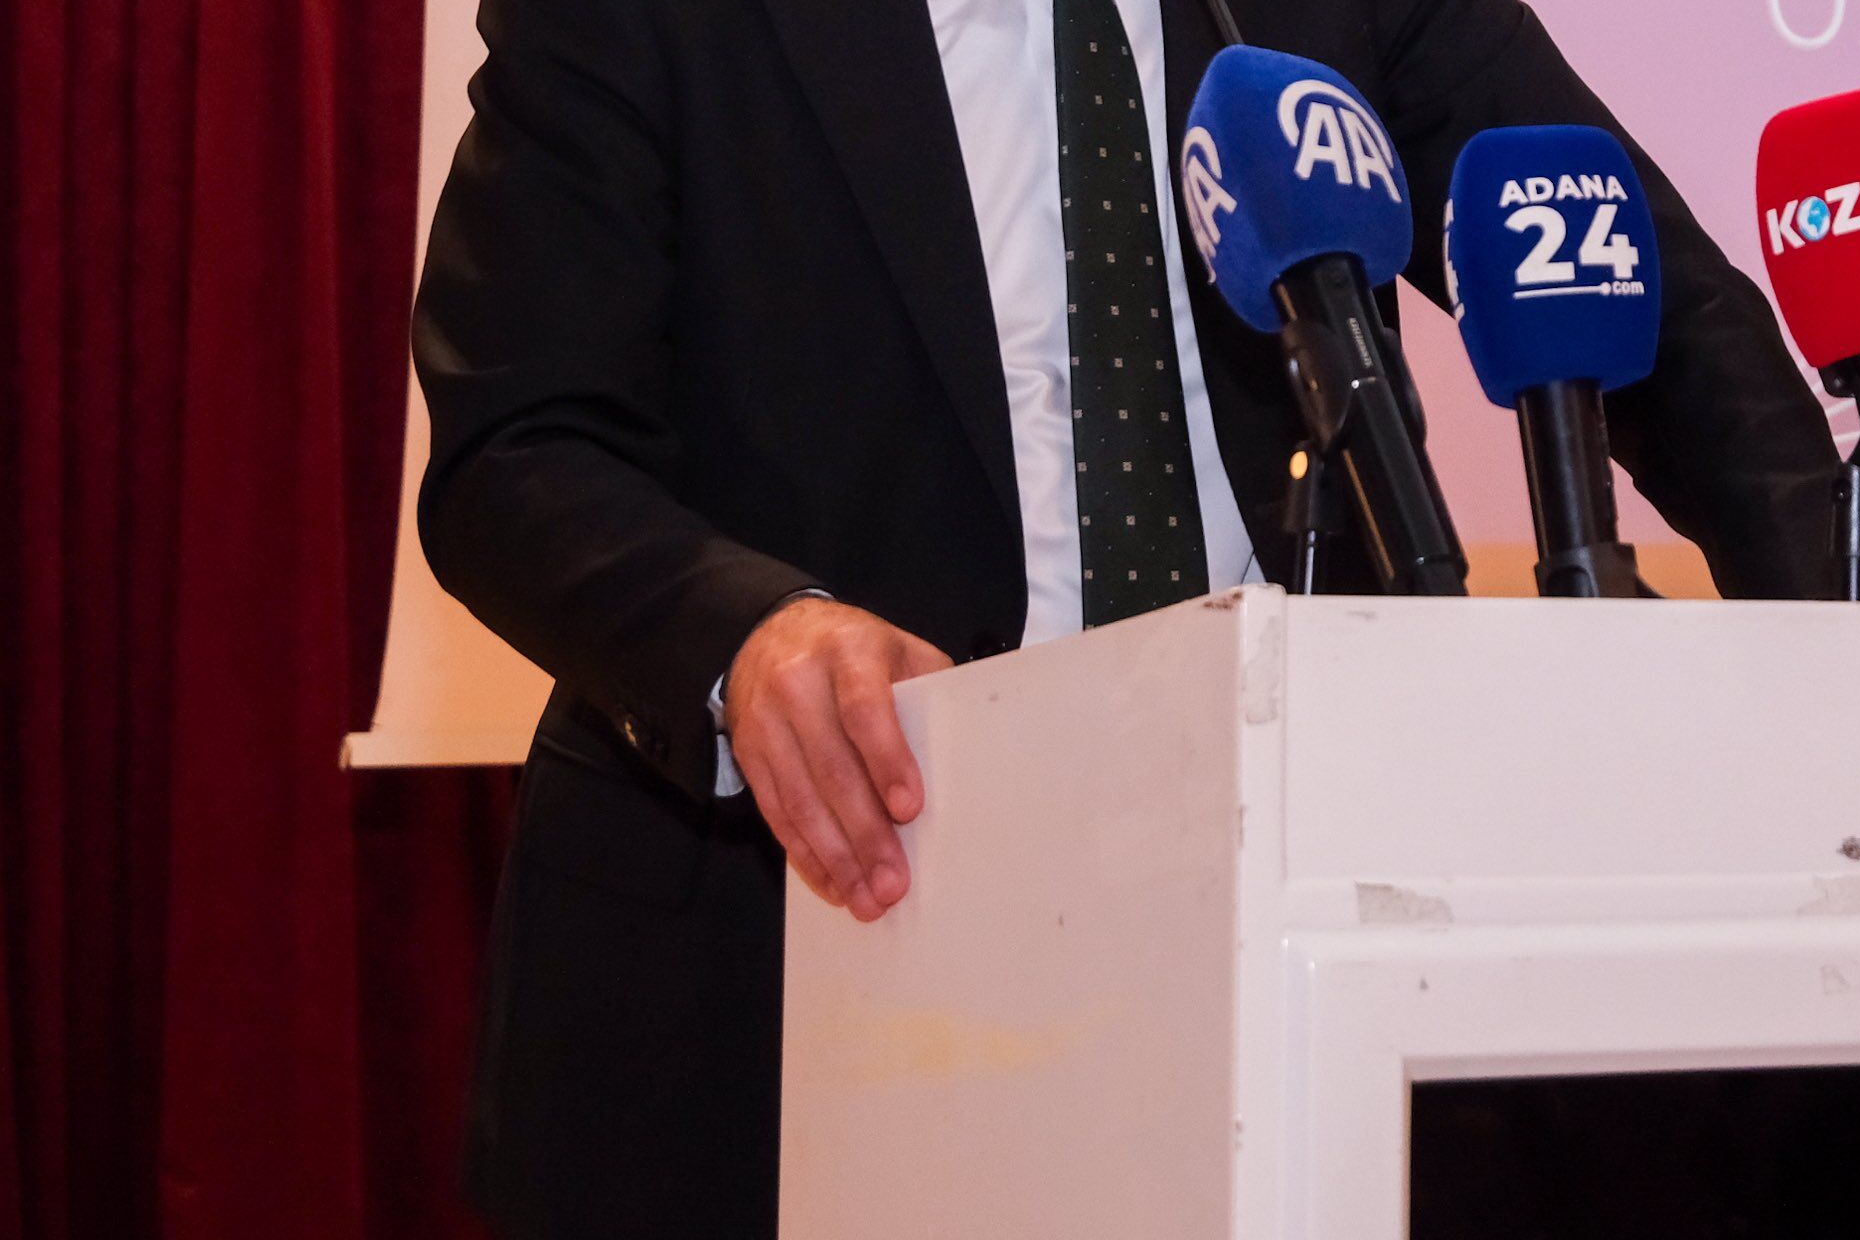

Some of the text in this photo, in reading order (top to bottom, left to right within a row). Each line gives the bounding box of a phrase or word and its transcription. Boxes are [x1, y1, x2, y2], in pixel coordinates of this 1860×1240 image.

[1294, 101, 1402, 203] AA
[1499, 173, 1629, 208] ADANA
[1503, 203, 1640, 286] 24
